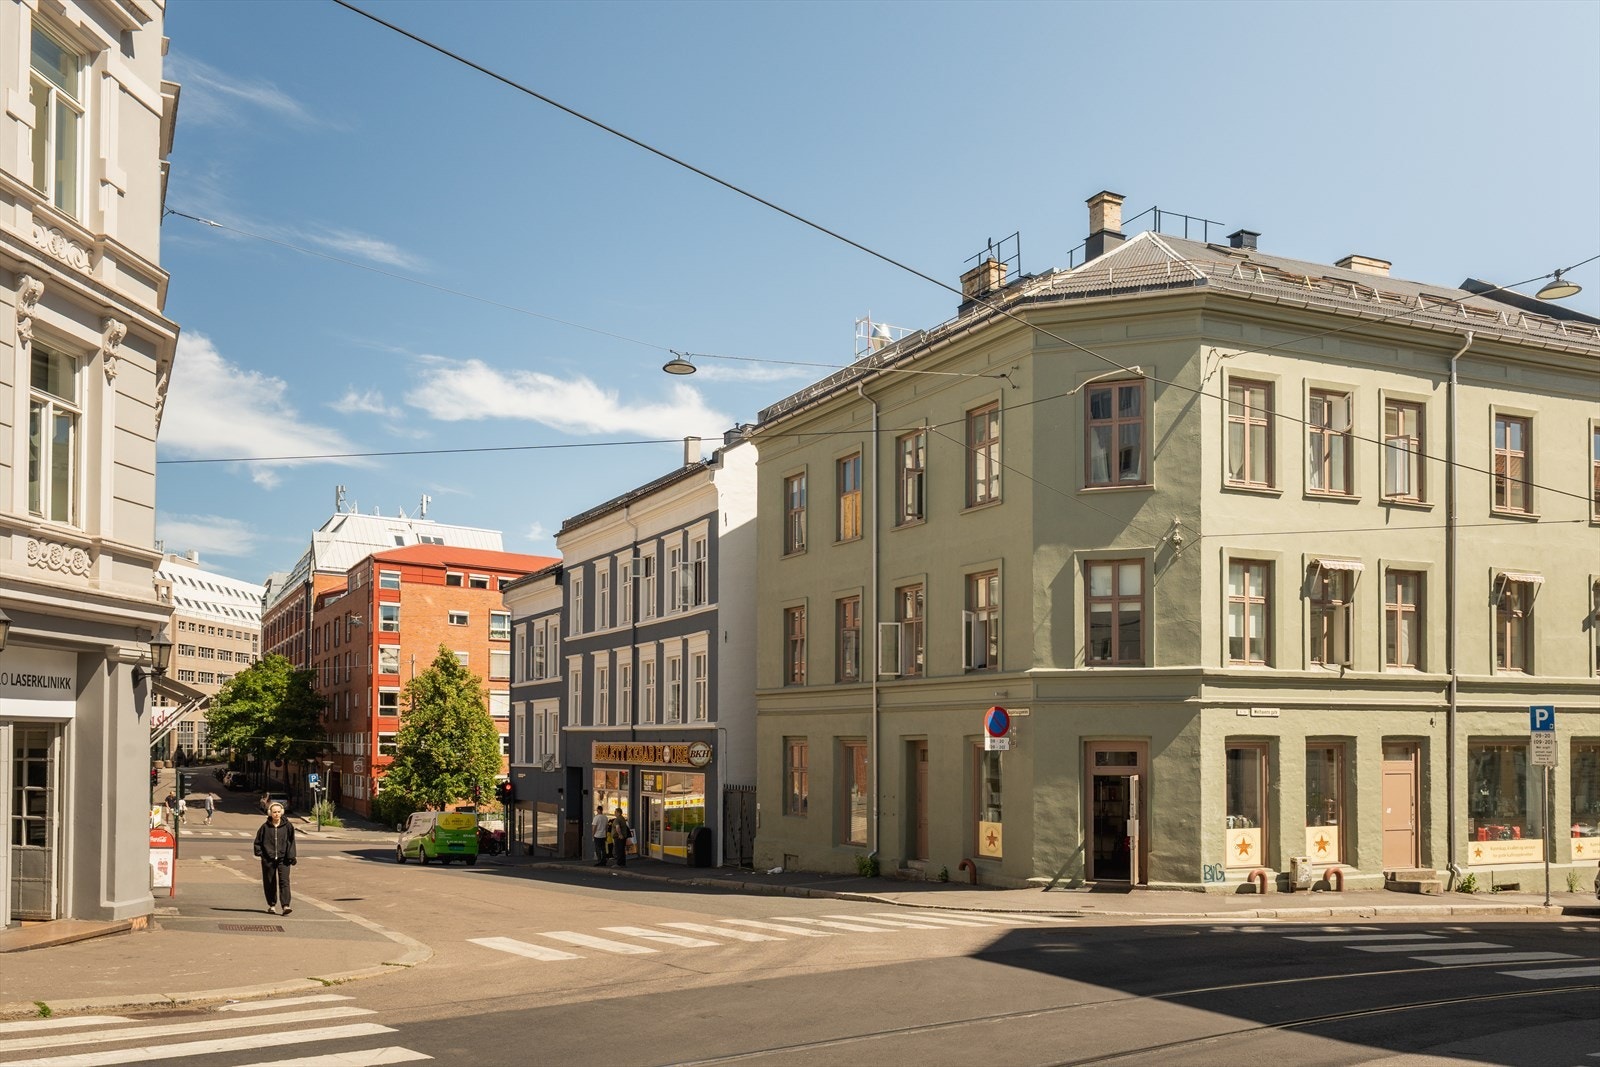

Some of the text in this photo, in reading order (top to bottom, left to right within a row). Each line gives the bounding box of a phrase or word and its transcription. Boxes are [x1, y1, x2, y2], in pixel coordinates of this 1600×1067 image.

[0, 672, 71, 689] O LASERKLINIKK
[1535, 708, 1549, 728] P
[690, 749, 709, 758] BKH
